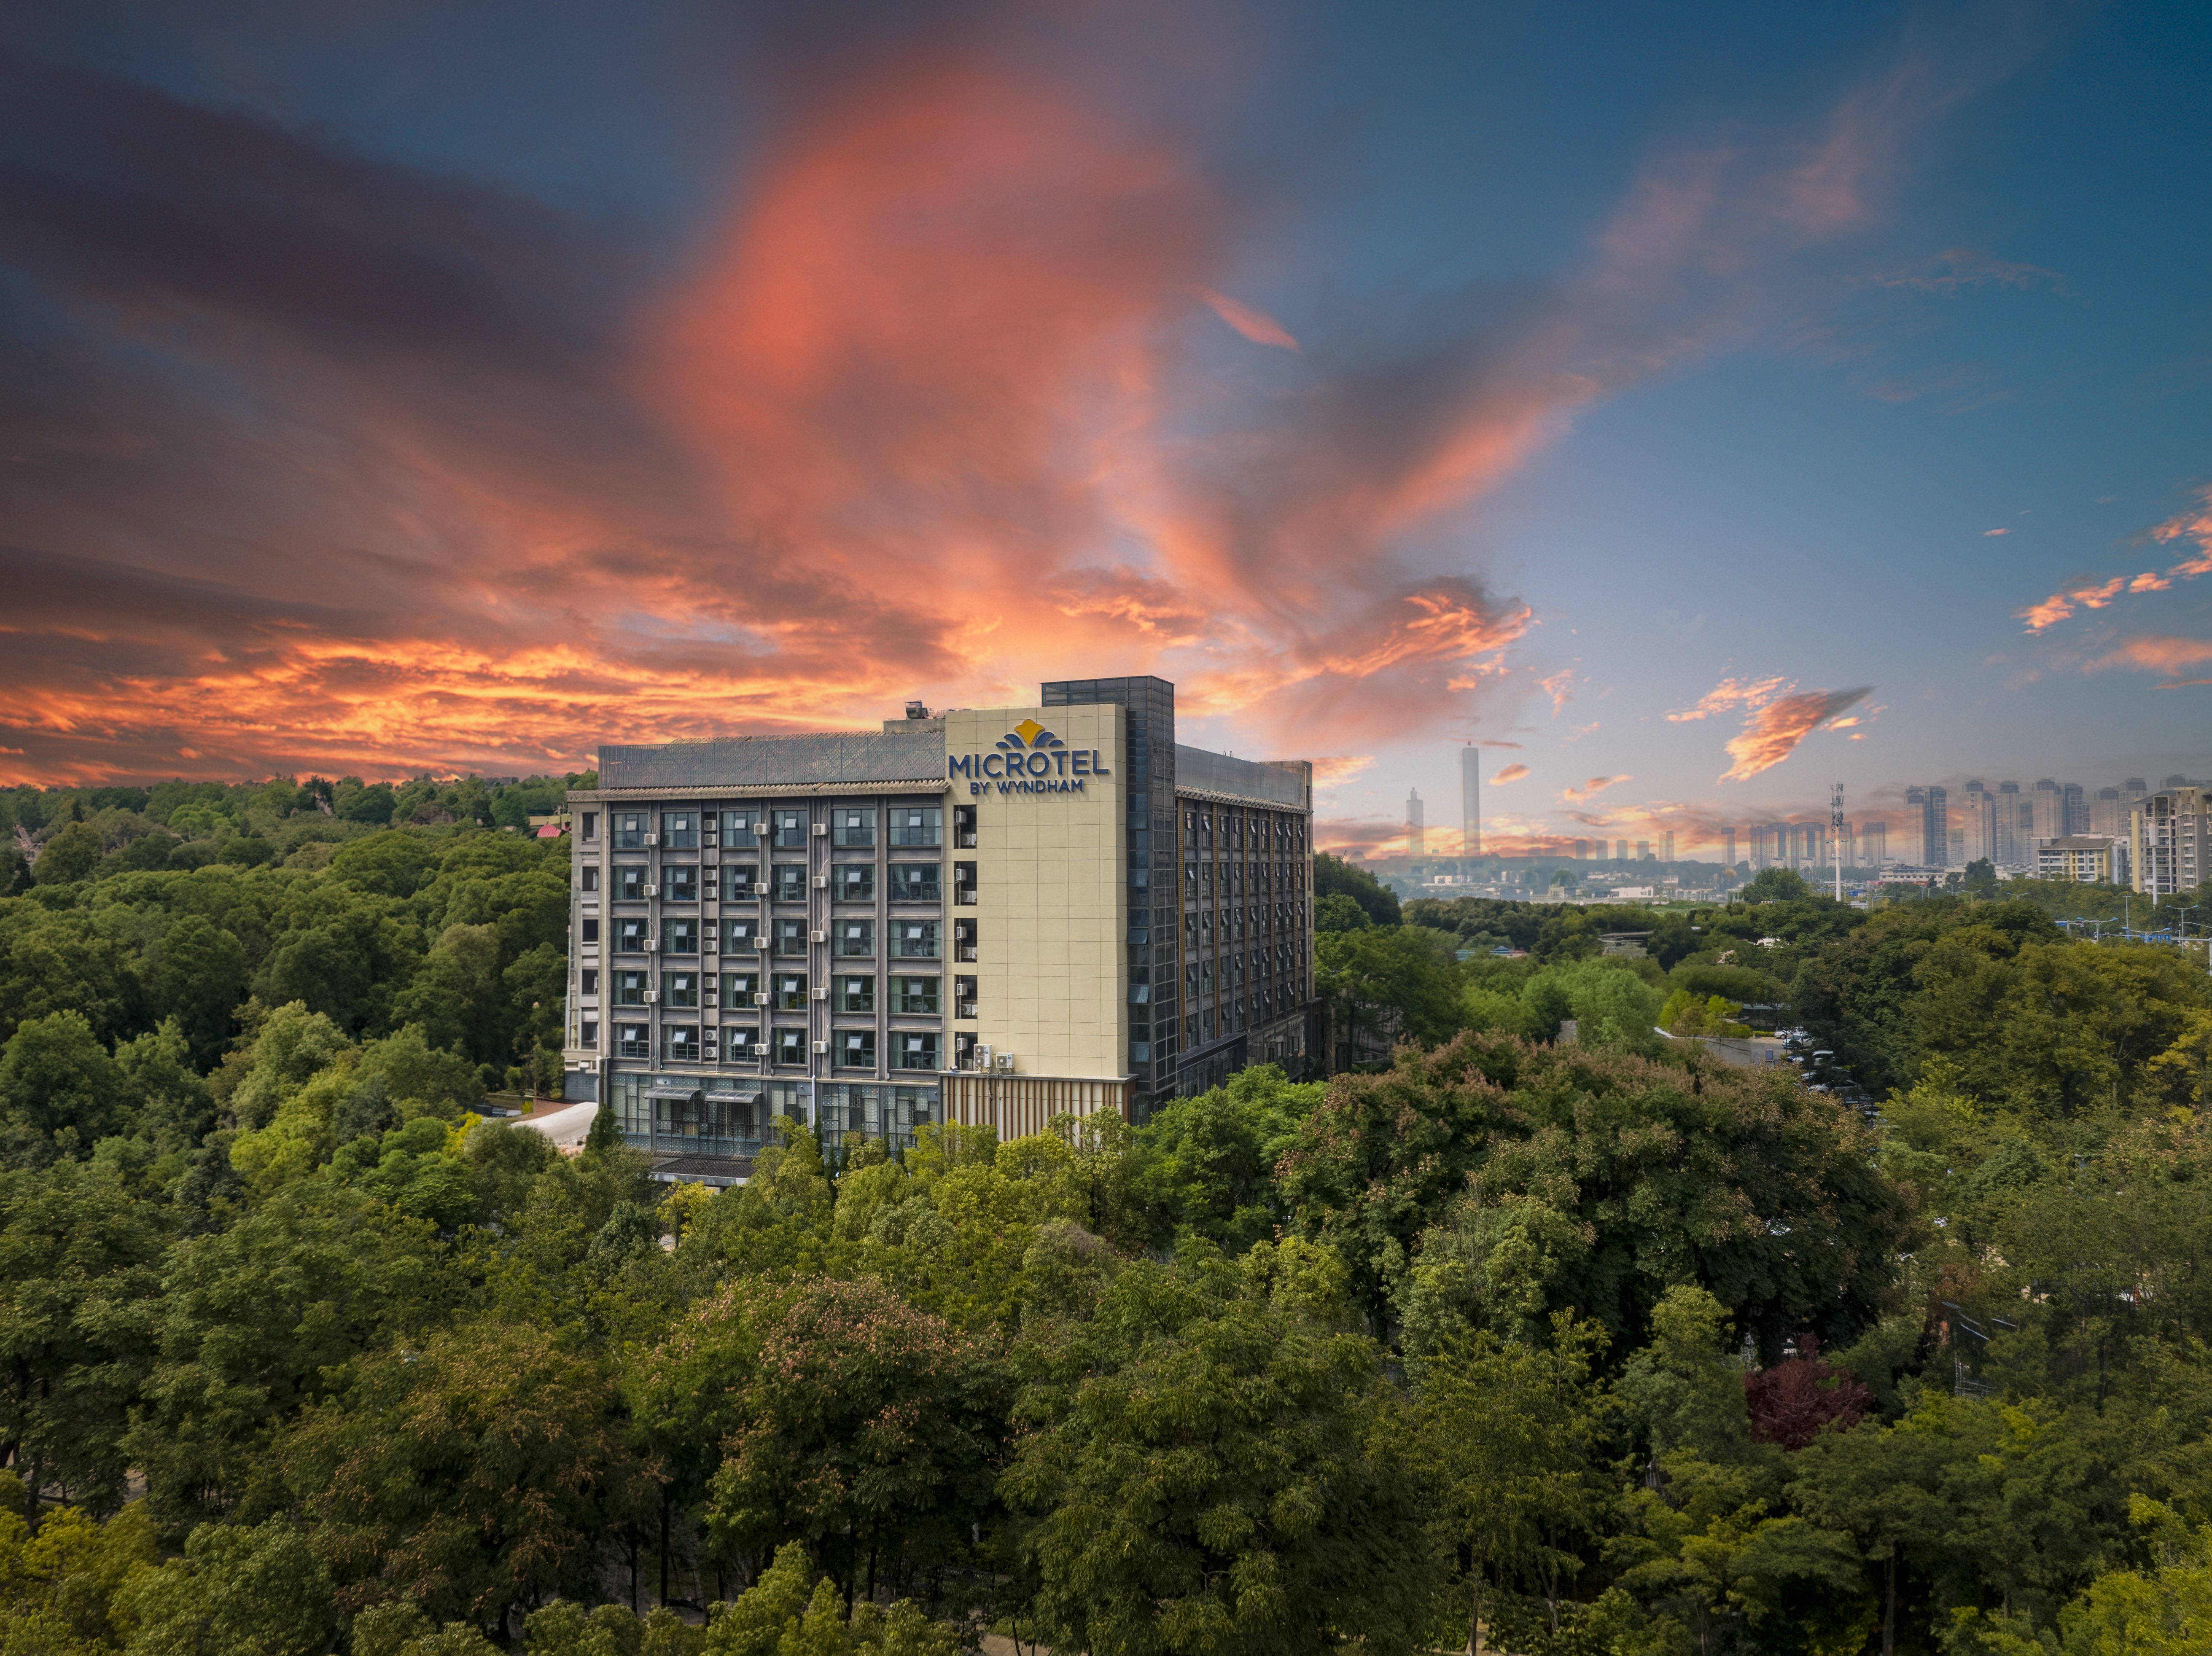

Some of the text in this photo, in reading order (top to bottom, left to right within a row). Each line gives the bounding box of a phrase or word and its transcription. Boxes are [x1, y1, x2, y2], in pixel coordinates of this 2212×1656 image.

[949, 750, 1109, 778] MICROTEL
[970, 779, 1083, 794] BY WYNDHAM
